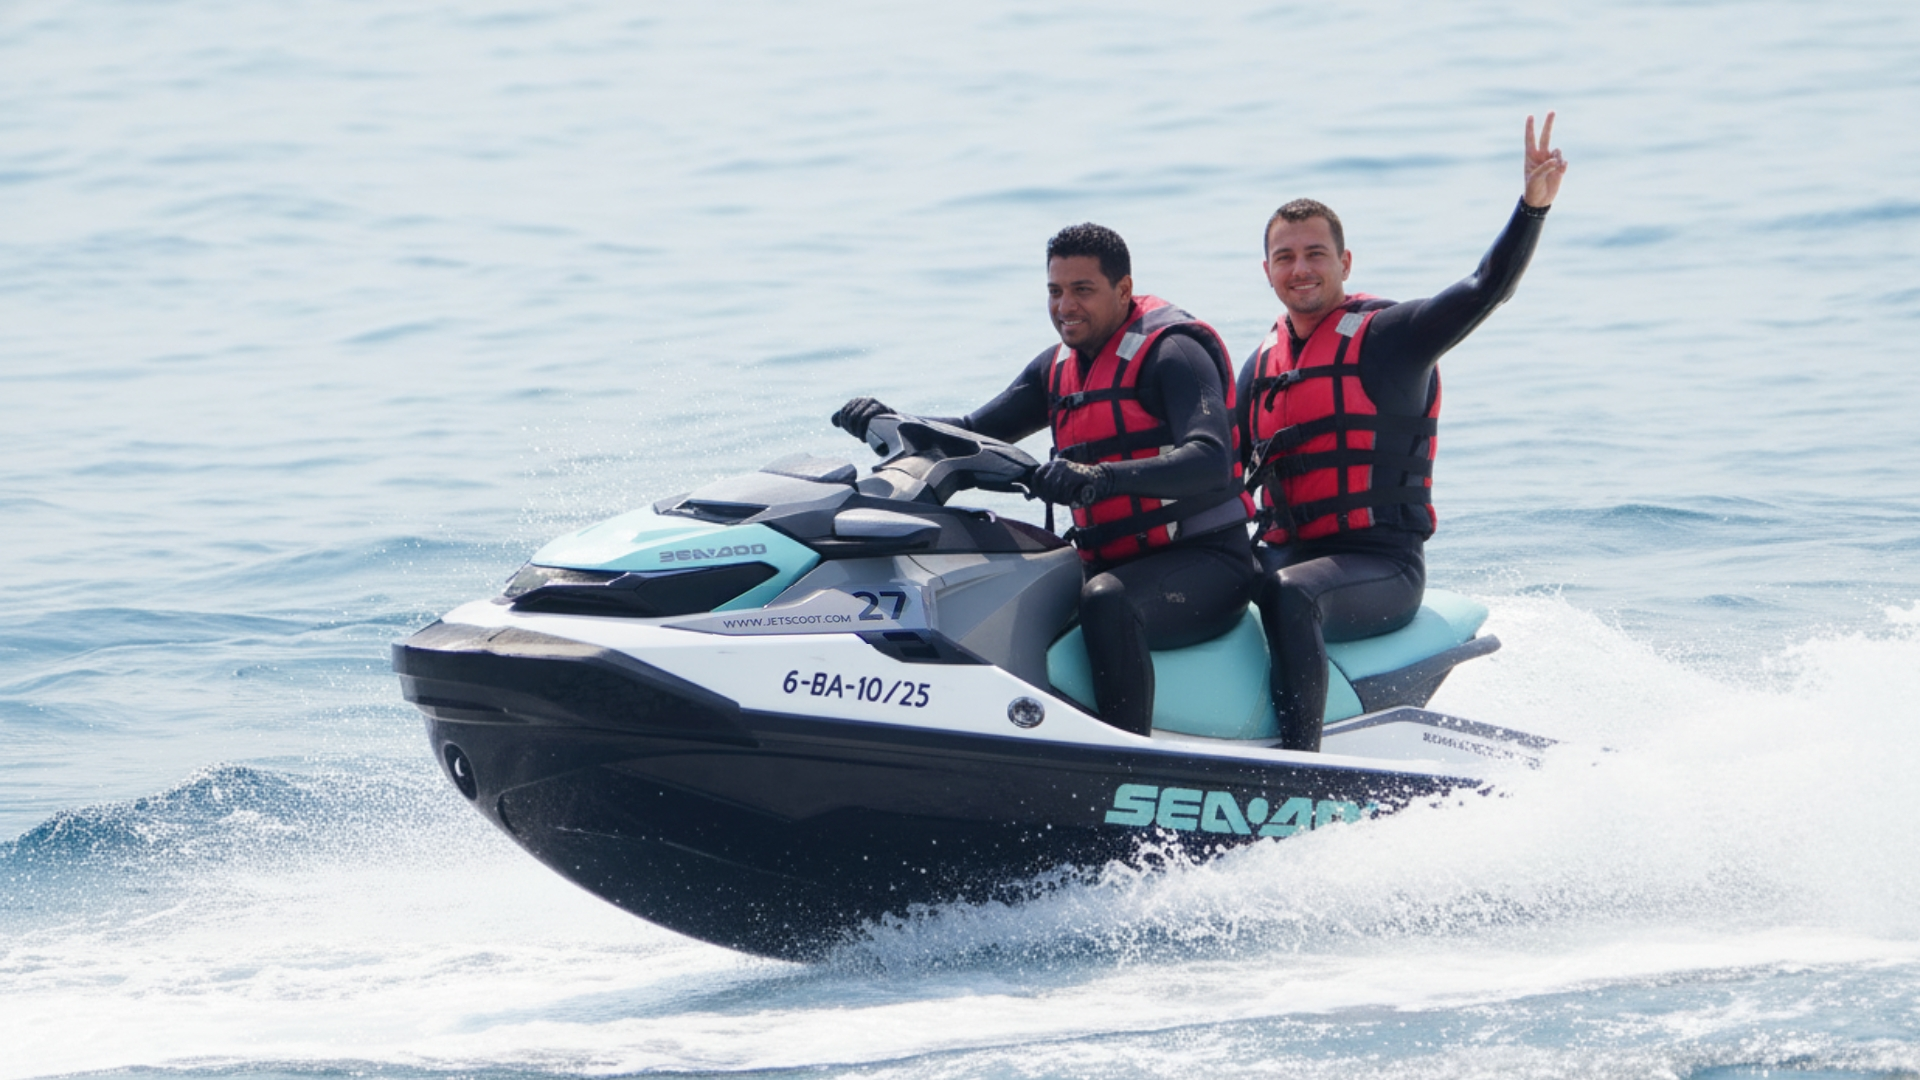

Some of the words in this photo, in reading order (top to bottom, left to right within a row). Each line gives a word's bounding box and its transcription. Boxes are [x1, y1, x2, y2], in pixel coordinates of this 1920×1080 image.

[852, 591, 907, 621] 27
[723, 614, 852, 629] WWW.JETSCOOT.COM
[783, 670, 931, 708] 6-BA-10/25
